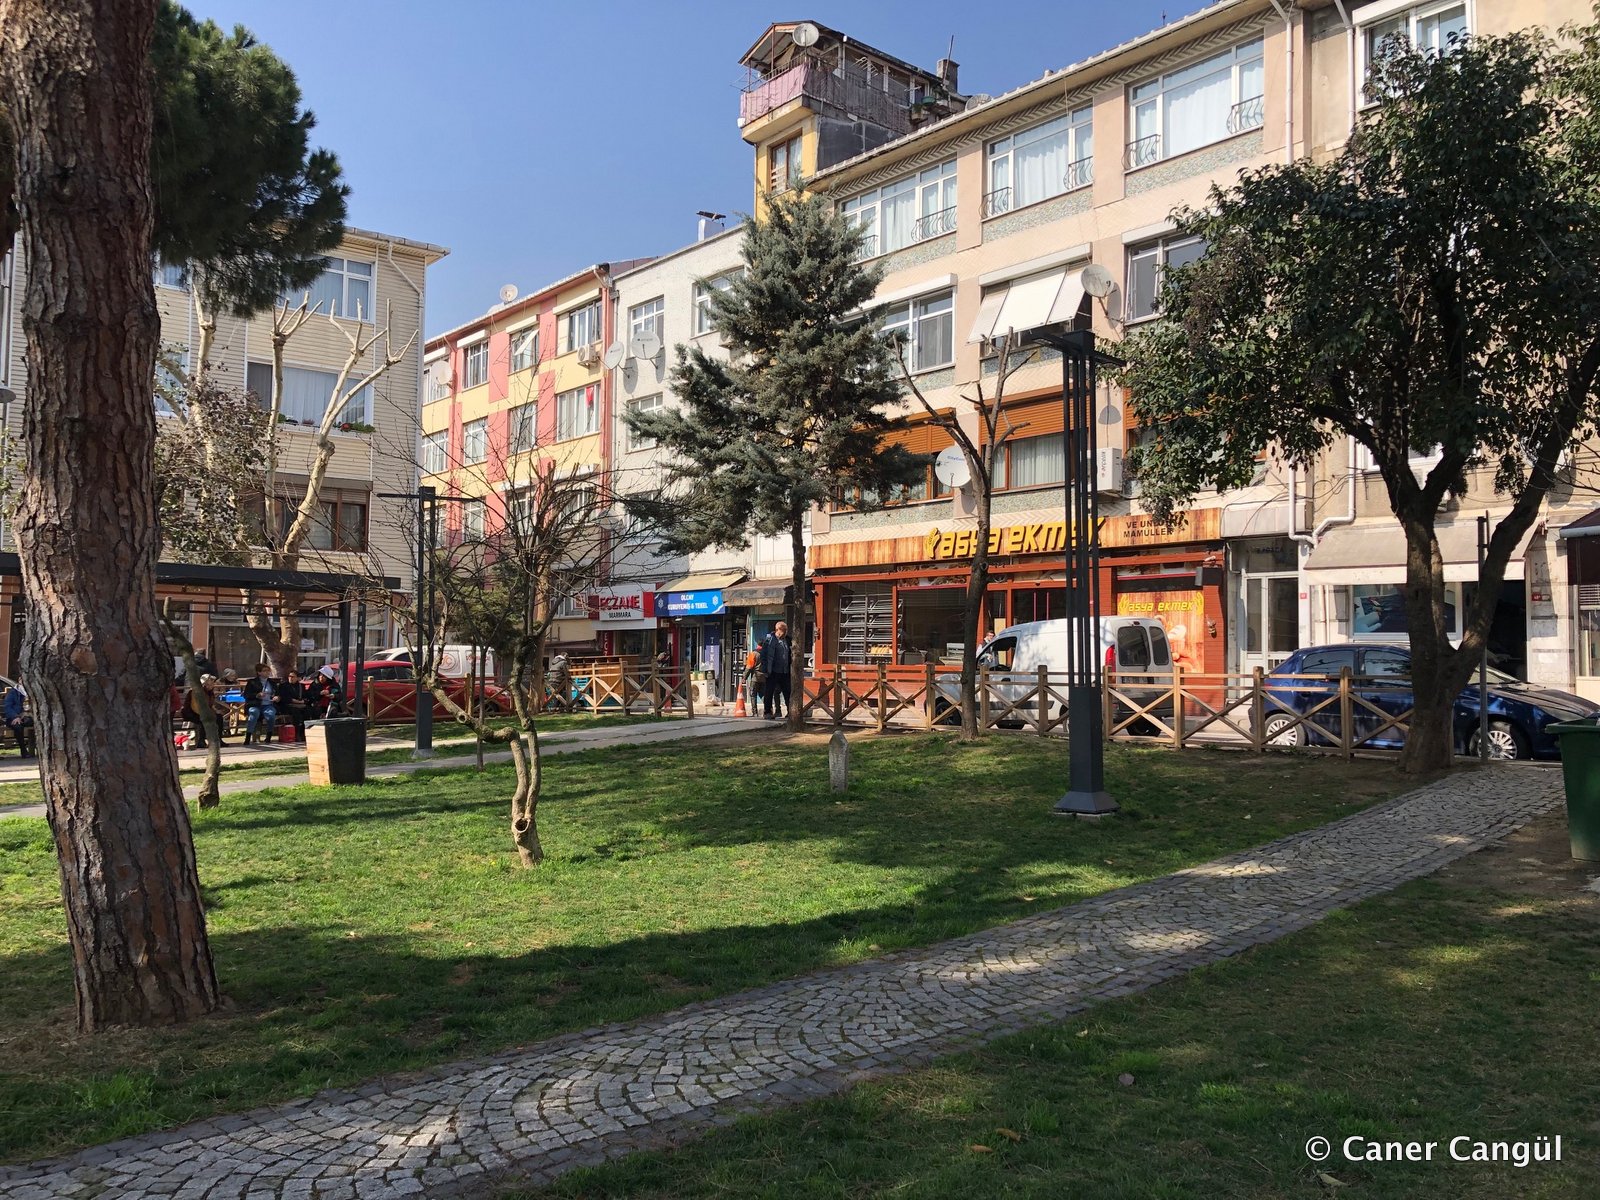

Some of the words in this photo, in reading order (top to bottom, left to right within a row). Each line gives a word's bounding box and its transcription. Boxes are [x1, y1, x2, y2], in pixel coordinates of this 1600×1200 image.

[1126, 521, 1137, 529] VE
[1129, 602, 1154, 612] asya
[1158, 601, 1194, 612] ekmek
